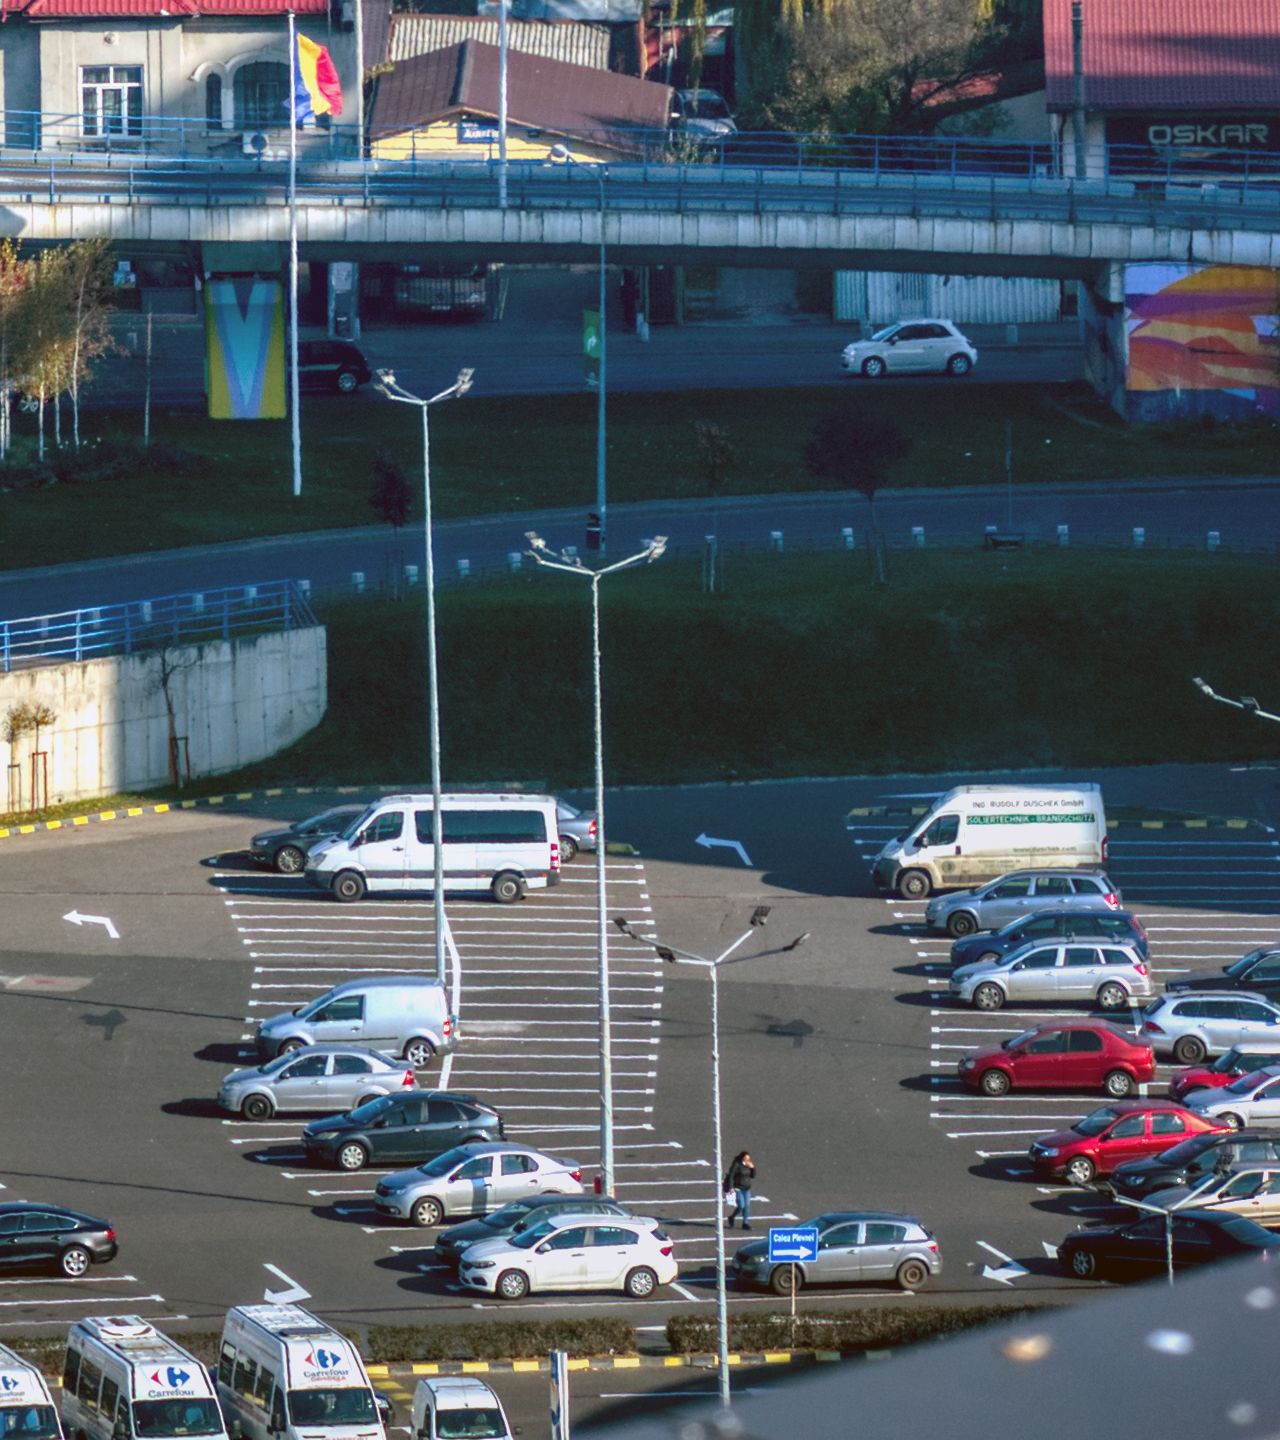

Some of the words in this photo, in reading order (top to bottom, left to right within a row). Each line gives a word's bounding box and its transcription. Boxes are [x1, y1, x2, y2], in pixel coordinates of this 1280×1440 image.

[1148, 124, 1269, 144] OSKAR
[989, 800, 1020, 808] RUDOLF
[303, 1368, 349, 1379] Carrefour
[148, 1389, 195, 1399] Carrefour
